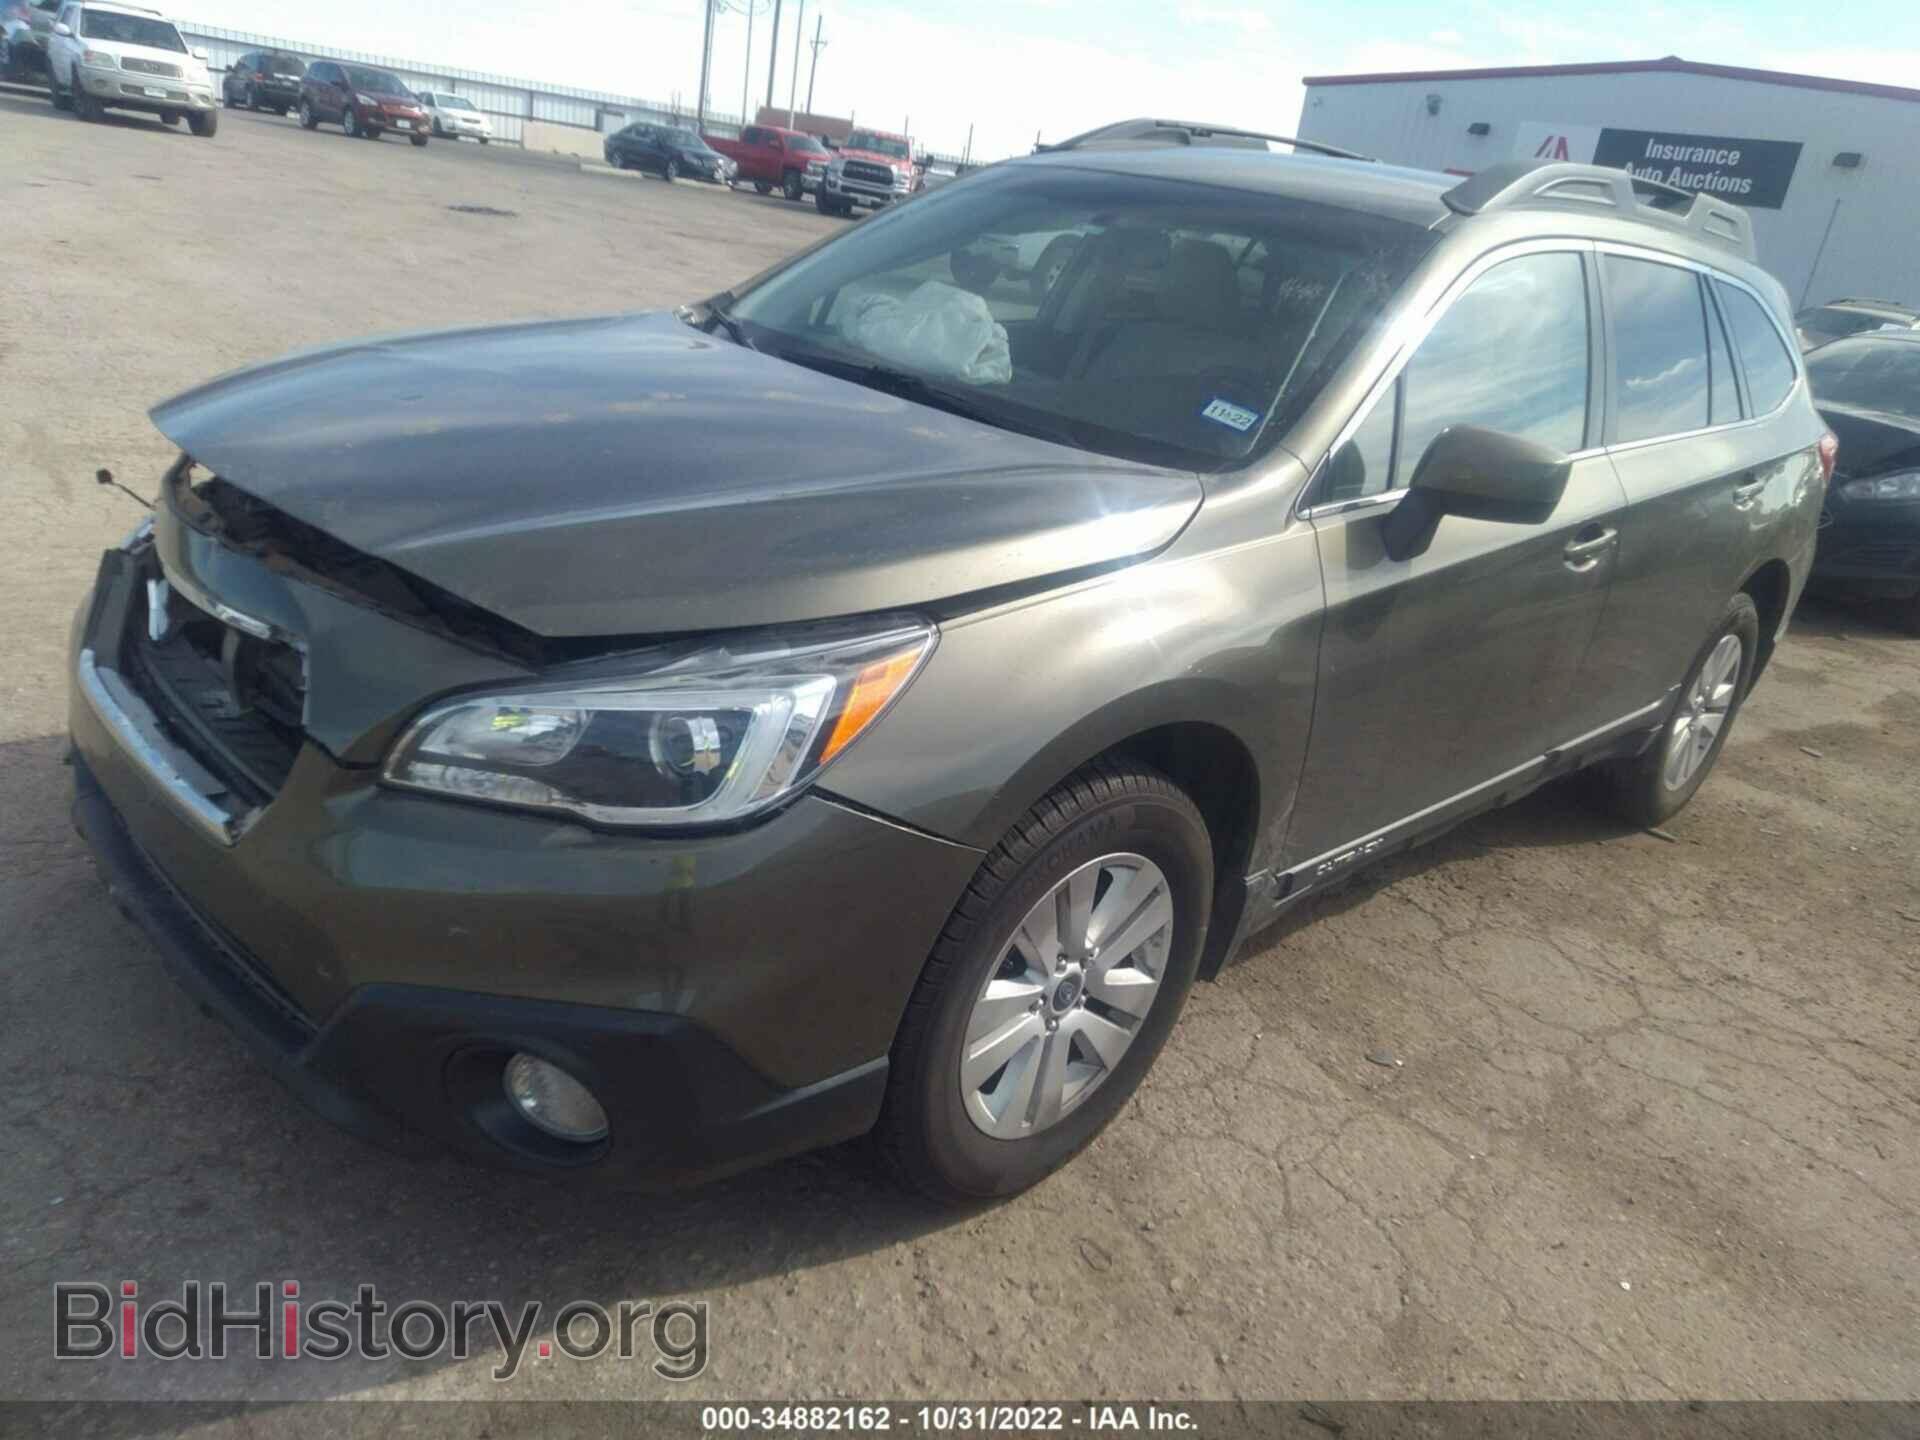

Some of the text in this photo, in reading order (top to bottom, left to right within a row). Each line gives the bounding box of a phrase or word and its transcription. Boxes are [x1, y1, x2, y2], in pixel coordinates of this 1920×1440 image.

[1644, 138, 1741, 166] Insurance
[1623, 161, 1753, 194] Auto Auctions
